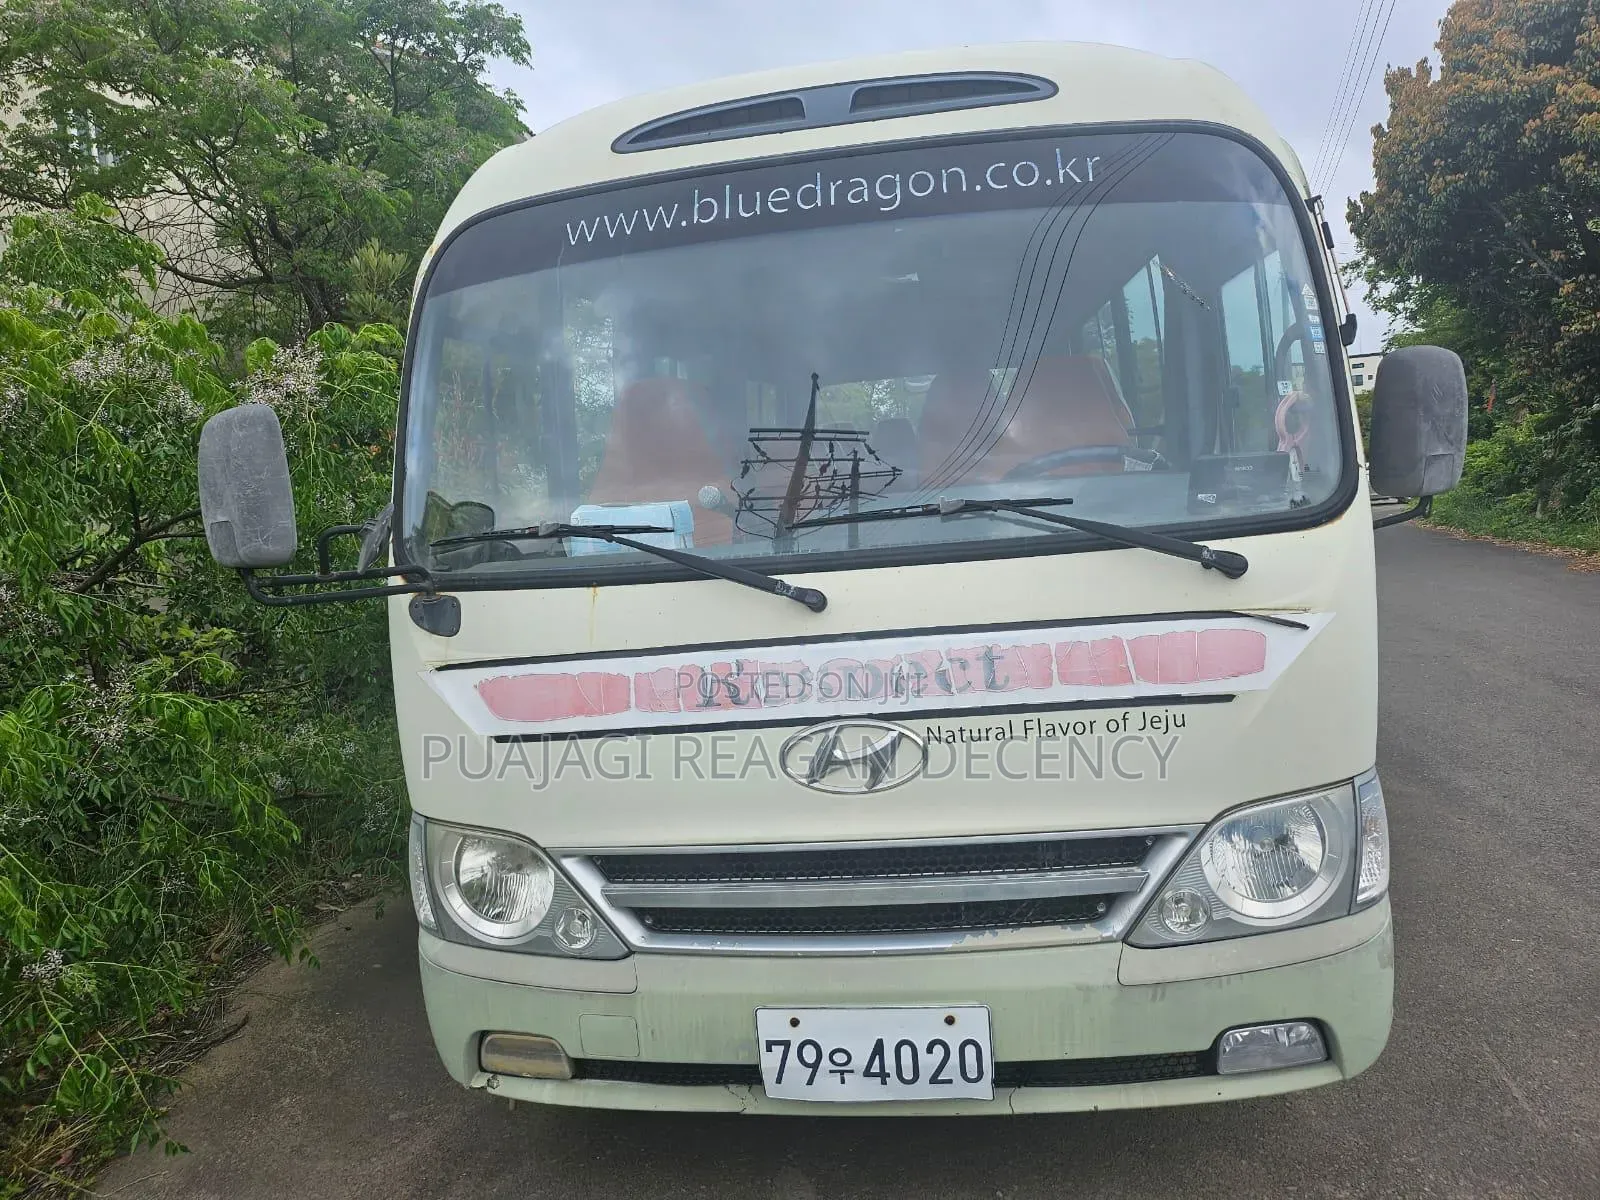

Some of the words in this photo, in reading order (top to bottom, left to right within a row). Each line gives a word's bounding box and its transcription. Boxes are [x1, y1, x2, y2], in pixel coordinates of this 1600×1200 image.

[566, 147, 1101, 246] www.bluedragon.co.kr
[926, 719, 1014, 744] Natural
[1023, 715, 1096, 740] Flavor
[1105, 712, 1130, 733] of
[1137, 709, 1188, 734] Jeju
